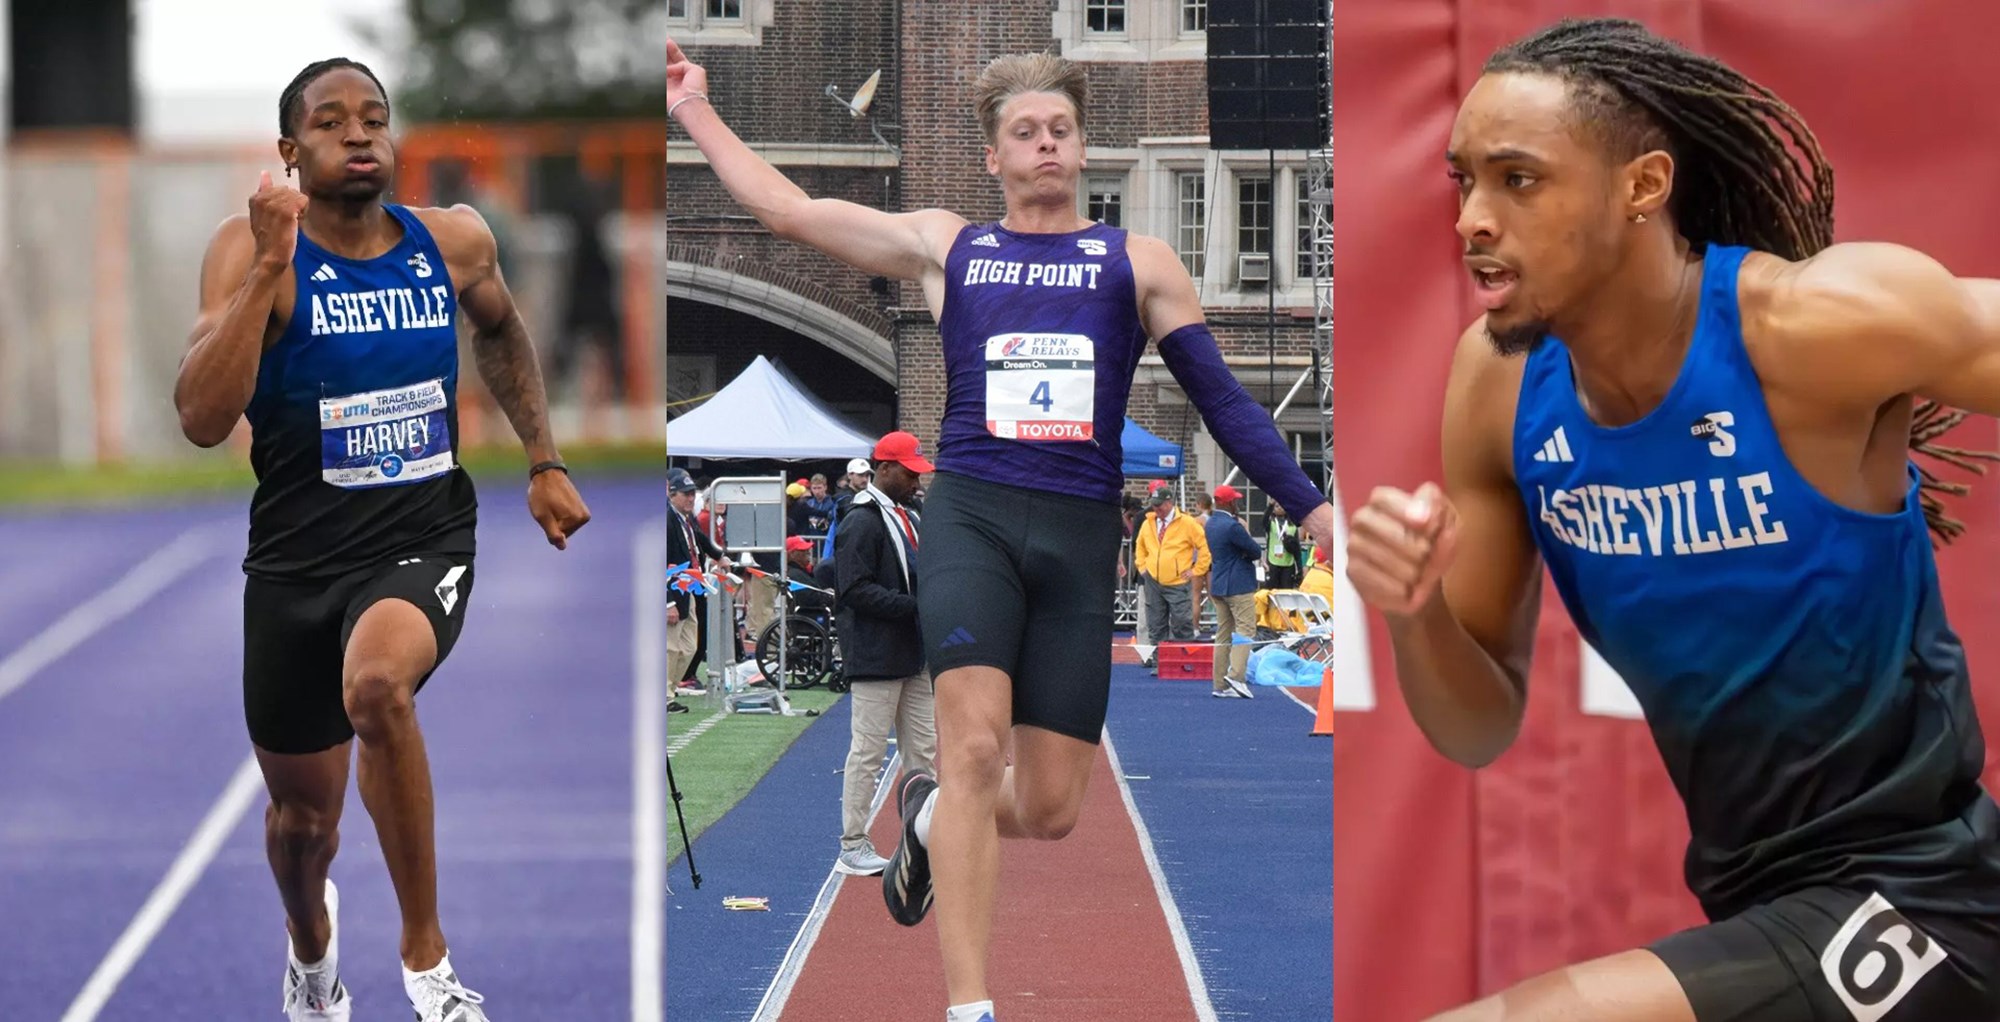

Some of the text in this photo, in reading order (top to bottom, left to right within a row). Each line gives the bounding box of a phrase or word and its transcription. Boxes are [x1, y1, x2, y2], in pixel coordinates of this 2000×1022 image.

[971, 239, 1000, 248] adidas
[964, 259, 1102, 290] HIGH POINT
[311, 285, 449, 336] ASHEVILLE
[1031, 347, 1080, 356] RELAYS
[1032, 338, 1069, 346] PENN
[1003, 361, 1047, 369] Dream On.
[371, 394, 443, 417] CHAMPIONSHIPS
[376, 385, 437, 406] TRACK & FIELD
[1029, 381, 1054, 412] 4
[346, 415, 429, 457] HARVEY
[1020, 424, 1083, 437] TOYOTA
[1690, 422, 1716, 436] BIG
[1538, 471, 1789, 557] ASHEVILLE
[1839, 909, 1929, 1006] 6
